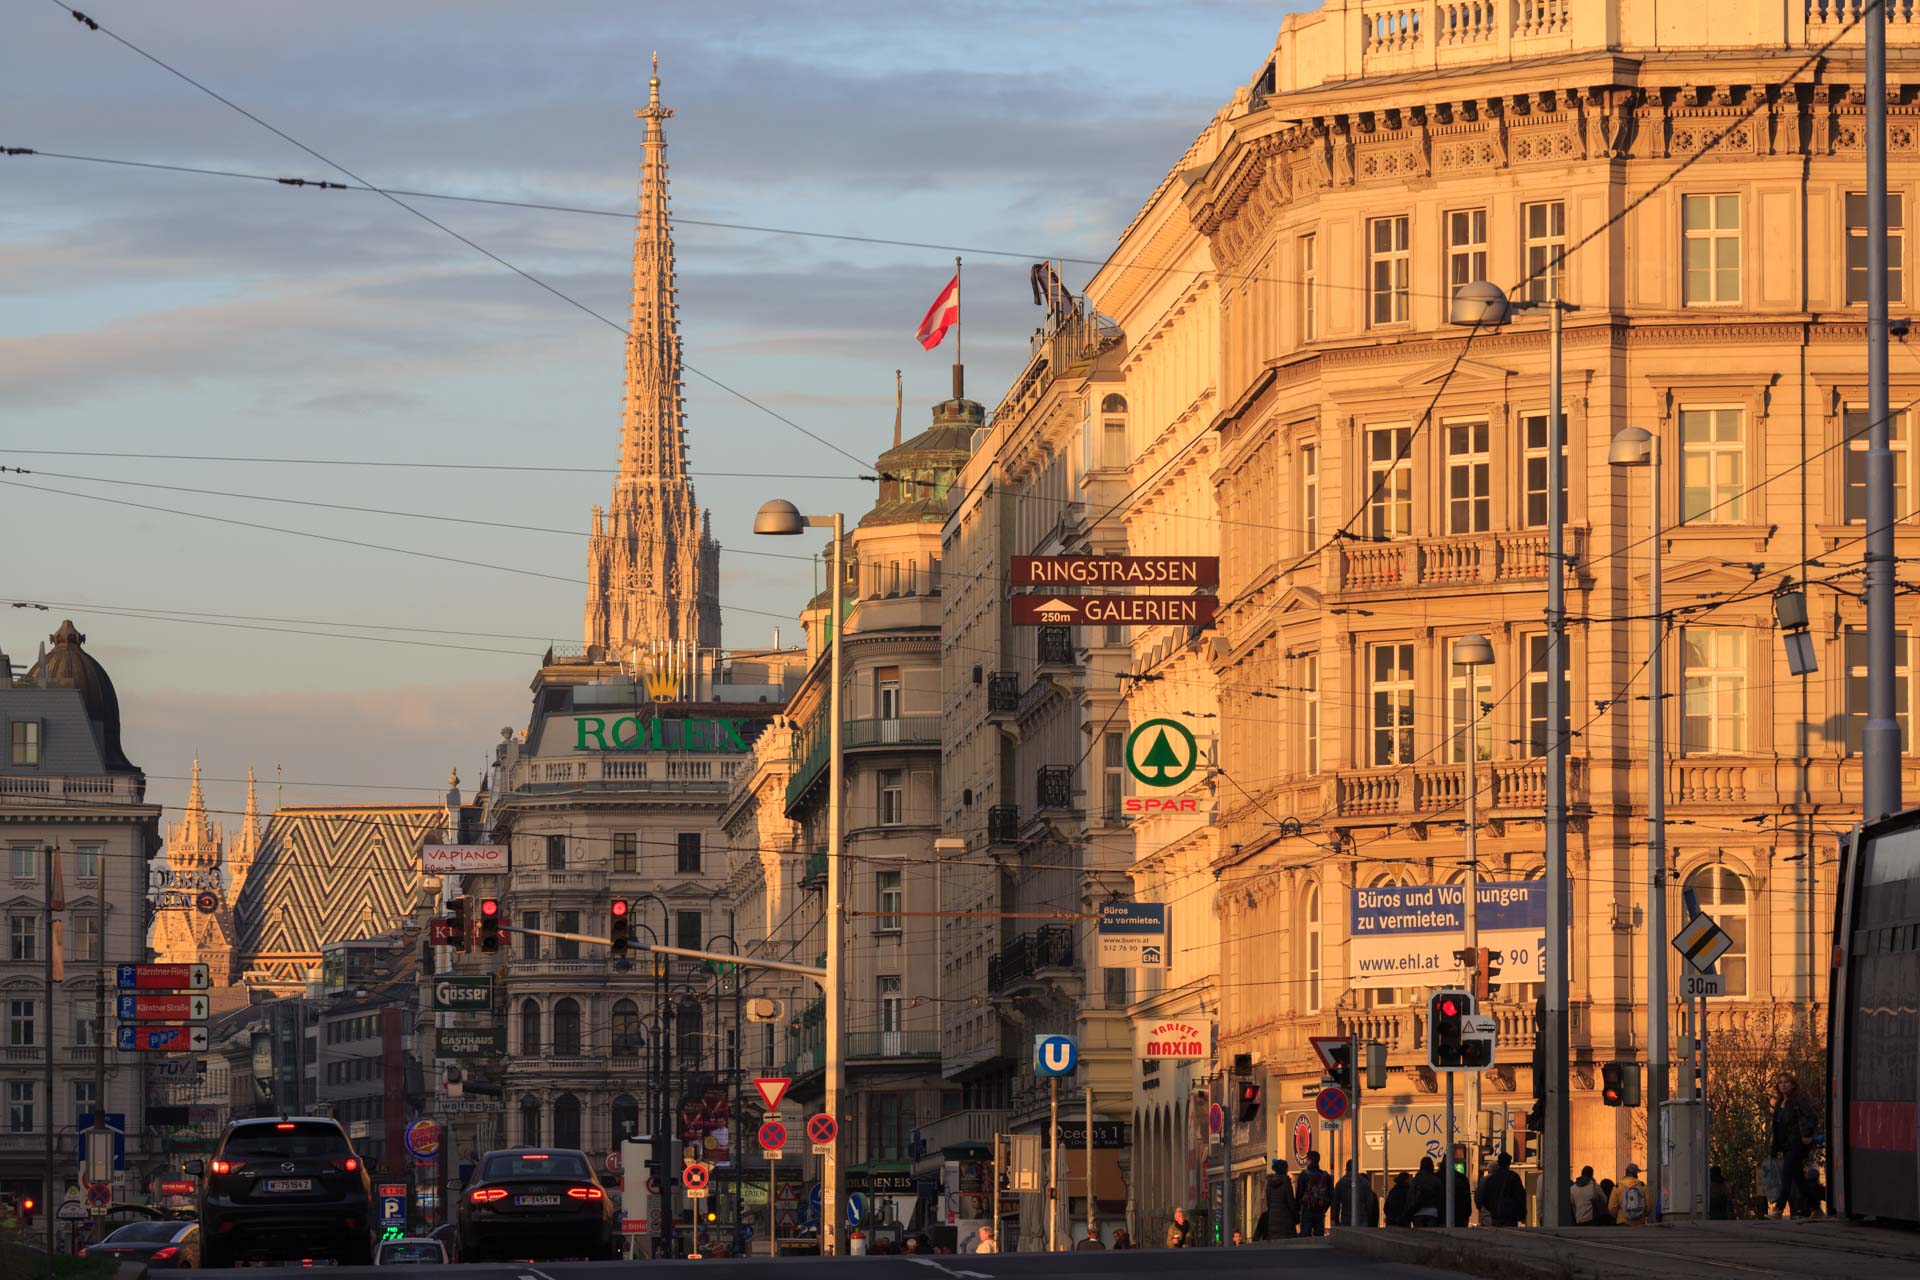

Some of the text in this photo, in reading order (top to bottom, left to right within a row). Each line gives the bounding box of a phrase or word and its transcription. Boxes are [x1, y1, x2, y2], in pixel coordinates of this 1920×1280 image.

[1031, 561, 1197, 581] RINGSTRASSEN
[1041, 612, 1071, 622] 250m
[1085, 600, 1197, 620] GALERIEN
[574, 717, 750, 750] ROLEX
[1126, 799, 1197, 812] SPAR
[1357, 887, 1529, 909] Büros und Wonungen
[1103, 907, 1129, 915] Büros
[1116, 916, 1161, 925] vermieten.
[1357, 911, 1459, 930] zu vermieten.
[1143, 954, 1160, 963] EHL
[1359, 954, 1440, 971] www.ehl.at
[1510, 949, 1529, 966] 90
[436, 981, 487, 1005] Gösser
[1687, 977, 1718, 994] 30m
[137, 1004, 166, 1012] Kärntner
[1151, 1023, 1199, 1038] VARIETE
[441, 1036, 494, 1045] GASTHAUS
[452, 1044, 479, 1053] OPER
[1146, 1042, 1202, 1055] MAXIM
[1045, 1043, 1070, 1071] U
[159, 1060, 191, 1075] TÜV
[1395, 1113, 1443, 1136] WOK
